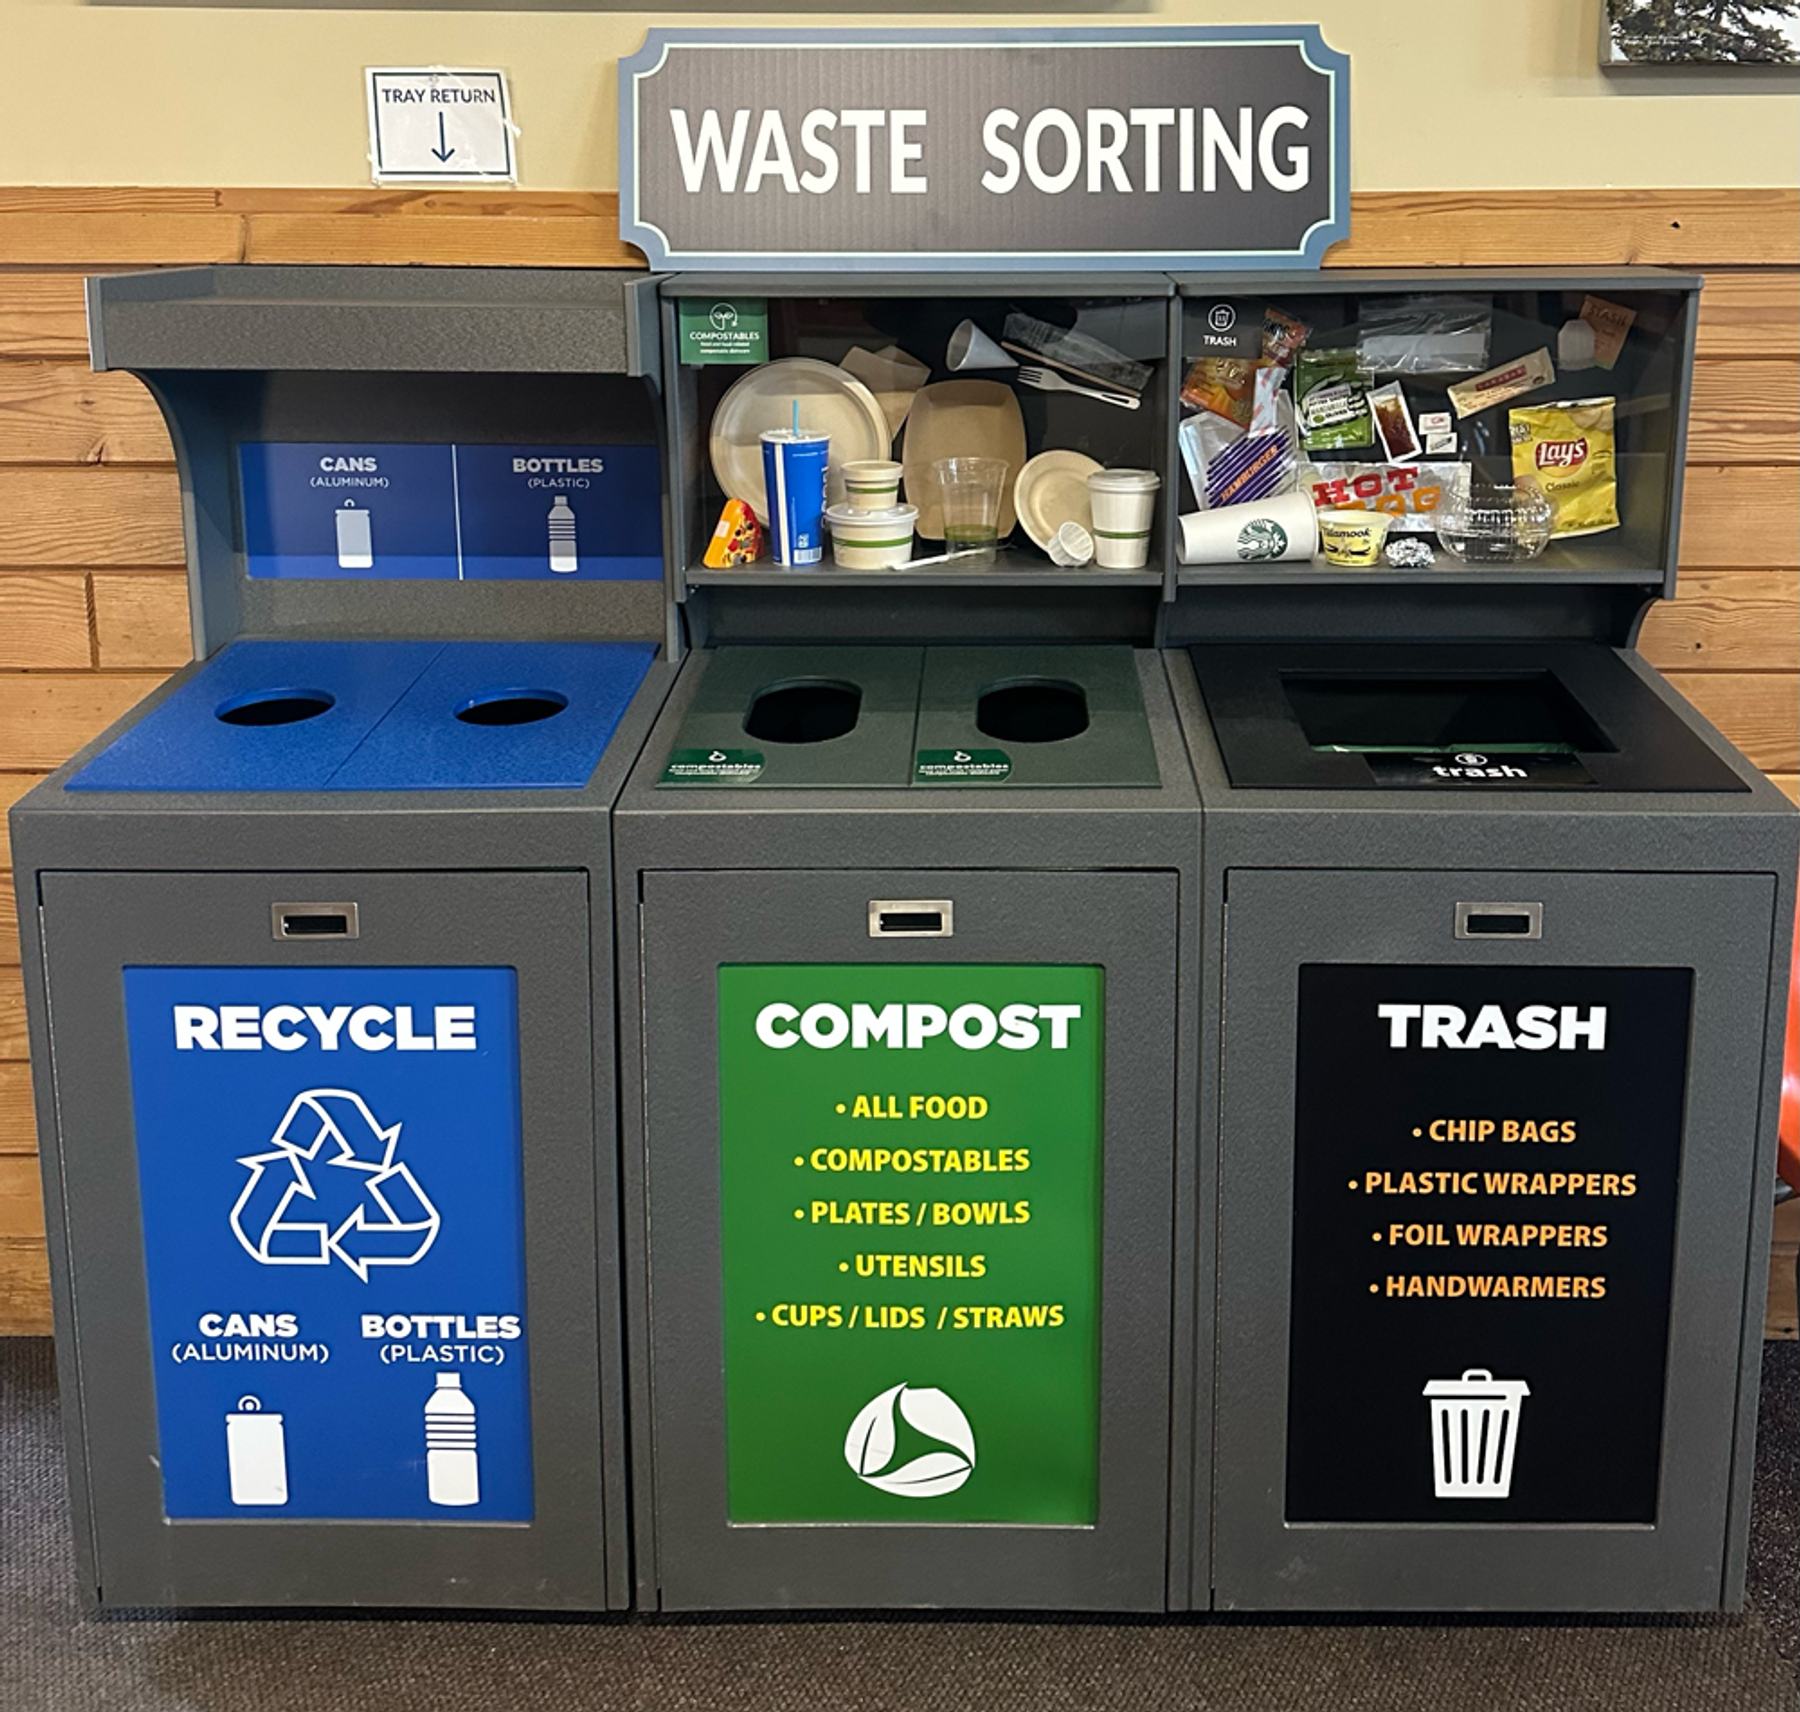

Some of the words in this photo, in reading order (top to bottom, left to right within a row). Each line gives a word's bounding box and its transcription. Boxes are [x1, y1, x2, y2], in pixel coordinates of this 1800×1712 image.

[382, 88, 426, 103] TRAY
[430, 89, 496, 104] RETURN
[669, 108, 928, 194] WASTE
[981, 106, 1310, 193] SORTING
[689, 331, 760, 341] COMPOSTABLES
[1203, 334, 1237, 347] TRASH
[319, 456, 378, 473] CANS
[513, 458, 604, 474] BOTTLES
[1220, 444, 1278, 502] HAMBURGER
[310, 476, 390, 489] (ALUMINUM)
[528, 477, 590, 489] (PLASTIC)
[1312, 466, 1420, 507] HOT
[919, 763, 1009, 771] compostables
[1432, 764, 1528, 778] trash
[174, 1005, 477, 1051] RECYCLE
[755, 1002, 1082, 1050] COMPOST
[1378, 1004, 1607, 1050] TRASH
[852, 1095, 903, 1119] ALL
[909, 1095, 988, 1119] FOOD
[1429, 1119, 1496, 1142] CHIP
[1502, 1120, 1576, 1143] BAGS
[810, 1148, 1030, 1173] COMPOSTABLES
[1365, 1171, 1478, 1195] PLASTIC
[1483, 1172, 1637, 1196] WRAPPERS
[811, 1201, 911, 1225] PLATES
[933, 1200, 1030, 1225] BOWLS
[1389, 1223, 1450, 1246] FOIL
[1456, 1224, 1608, 1247] WRAPPERS
[856, 1254, 986, 1278] UTENSILS
[1386, 1275, 1606, 1298] HANDWARMERS
[199, 1313, 299, 1338] CANS
[361, 1314, 521, 1339] BOTTLES
[771, 1304, 843, 1328] CUPS
[865, 1306, 925, 1329] LIDS
[171, 1343, 329, 1364] (ALUMINUM)
[379, 1344, 505, 1366] (PLASTIC)
